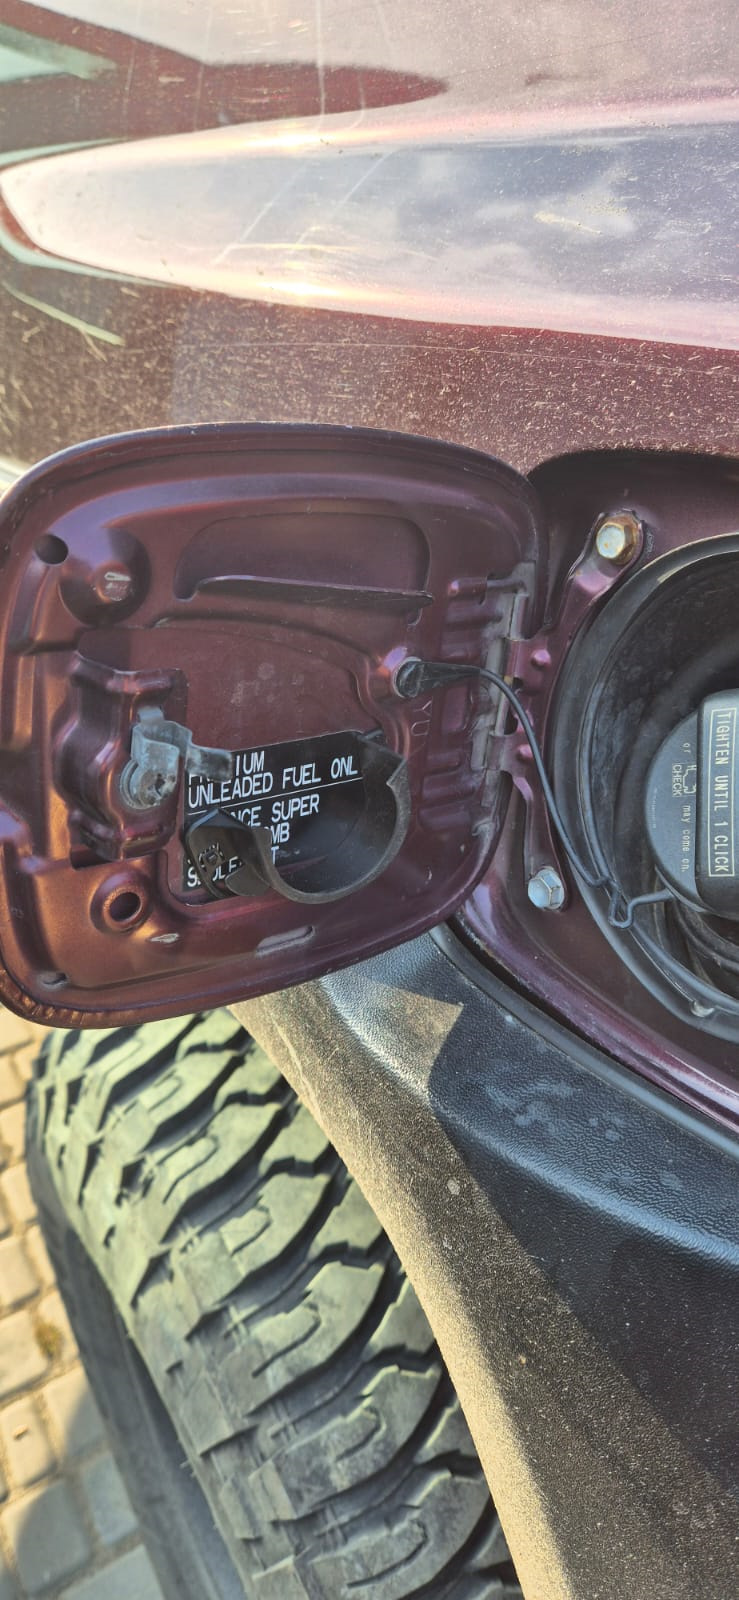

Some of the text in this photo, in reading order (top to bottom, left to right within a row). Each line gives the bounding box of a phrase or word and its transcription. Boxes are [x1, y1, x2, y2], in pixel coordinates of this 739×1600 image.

[682, 742, 690, 753] or
[715, 711, 732, 765] TIGHTEN
[188, 773, 273, 808] UNLEADED
[282, 763, 321, 789] FUEL
[331, 755, 359, 779] ONL
[672, 765, 682, 797] CHECK
[714, 775, 729, 811] UNTIL
[271, 794, 320, 823] SUPER
[680, 805, 691, 823] may
[682, 829, 691, 852] come
[714, 835, 729, 872] CLICK
